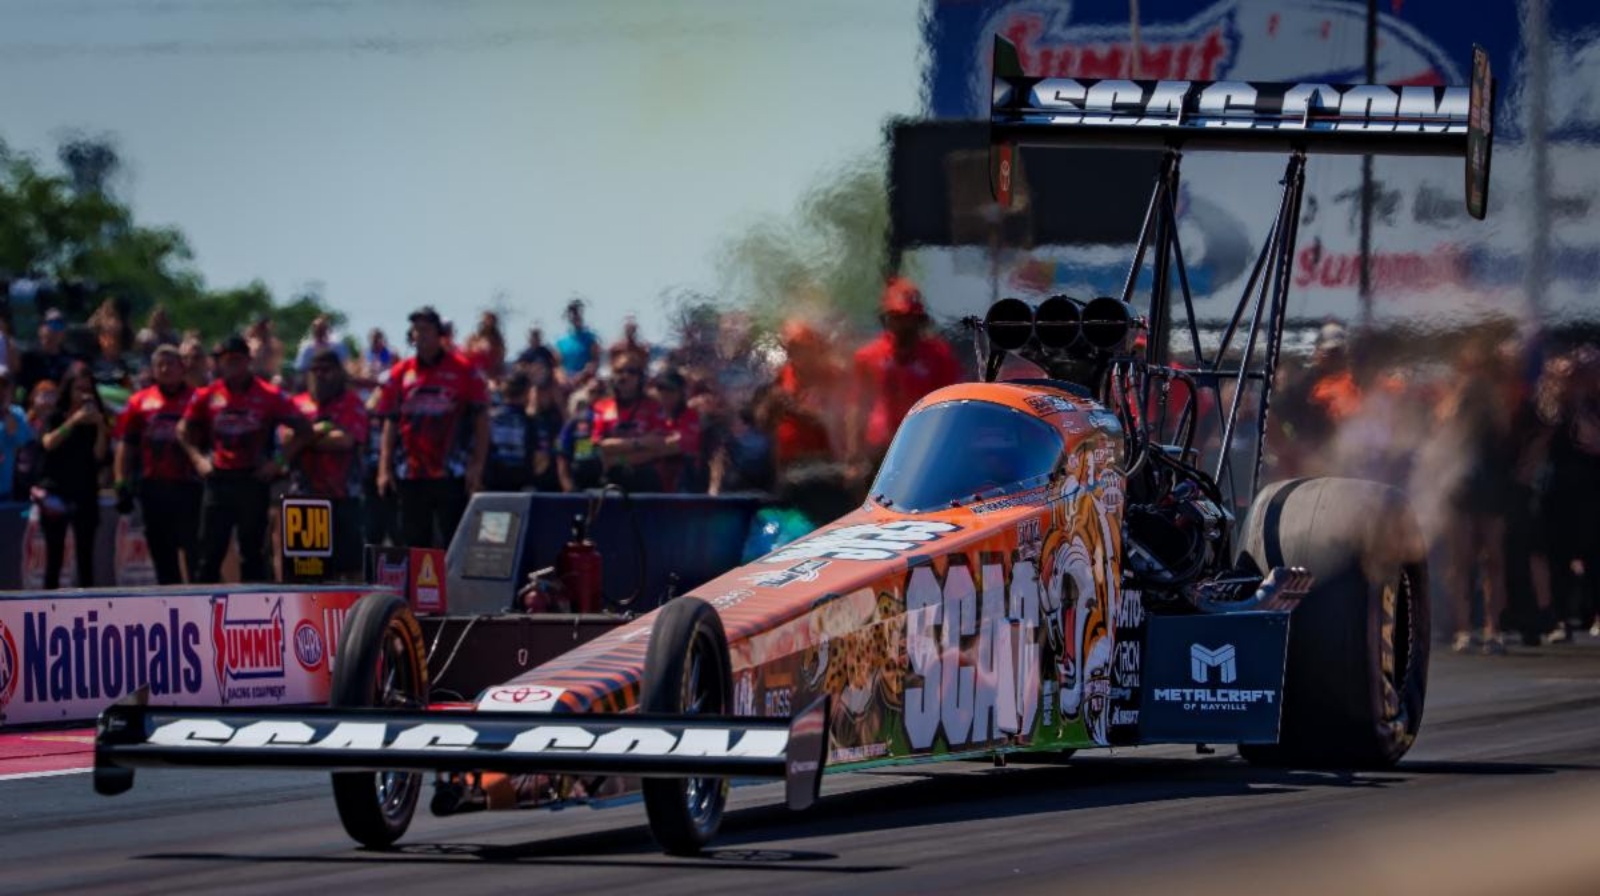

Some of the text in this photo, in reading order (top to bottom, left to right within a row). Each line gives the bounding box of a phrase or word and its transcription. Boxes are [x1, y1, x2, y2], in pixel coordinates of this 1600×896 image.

[286, 507, 330, 548] PJH
[23, 608, 202, 703] Nationals
[905, 562, 1040, 749] SCAG
[227, 686, 251, 699] RACING
[1154, 688, 1276, 703] METALCRAFT
[1200, 703, 1248, 711] MAYVILLE
[148, 719, 788, 756] SCAGCOM
